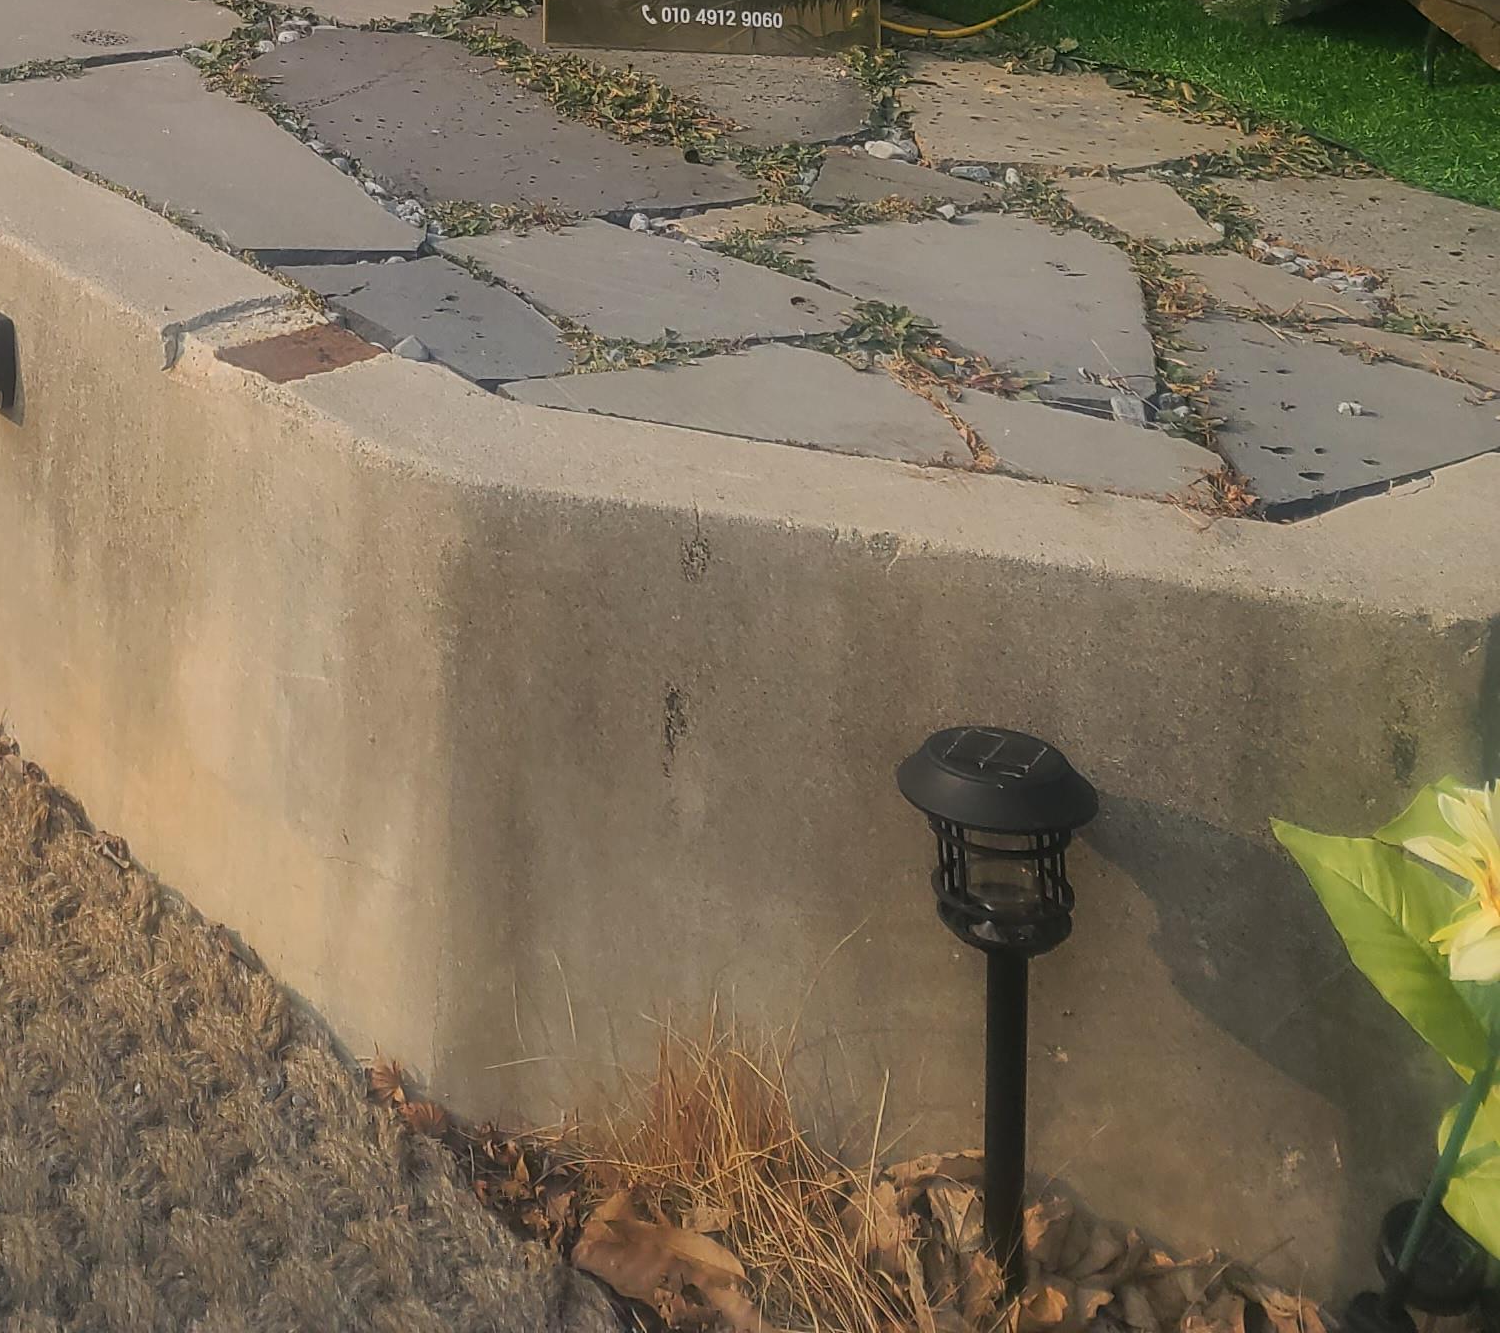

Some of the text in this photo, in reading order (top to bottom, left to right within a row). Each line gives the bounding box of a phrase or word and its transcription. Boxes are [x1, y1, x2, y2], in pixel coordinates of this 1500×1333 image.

[661, 7, 783, 29] 010 4912 9060
